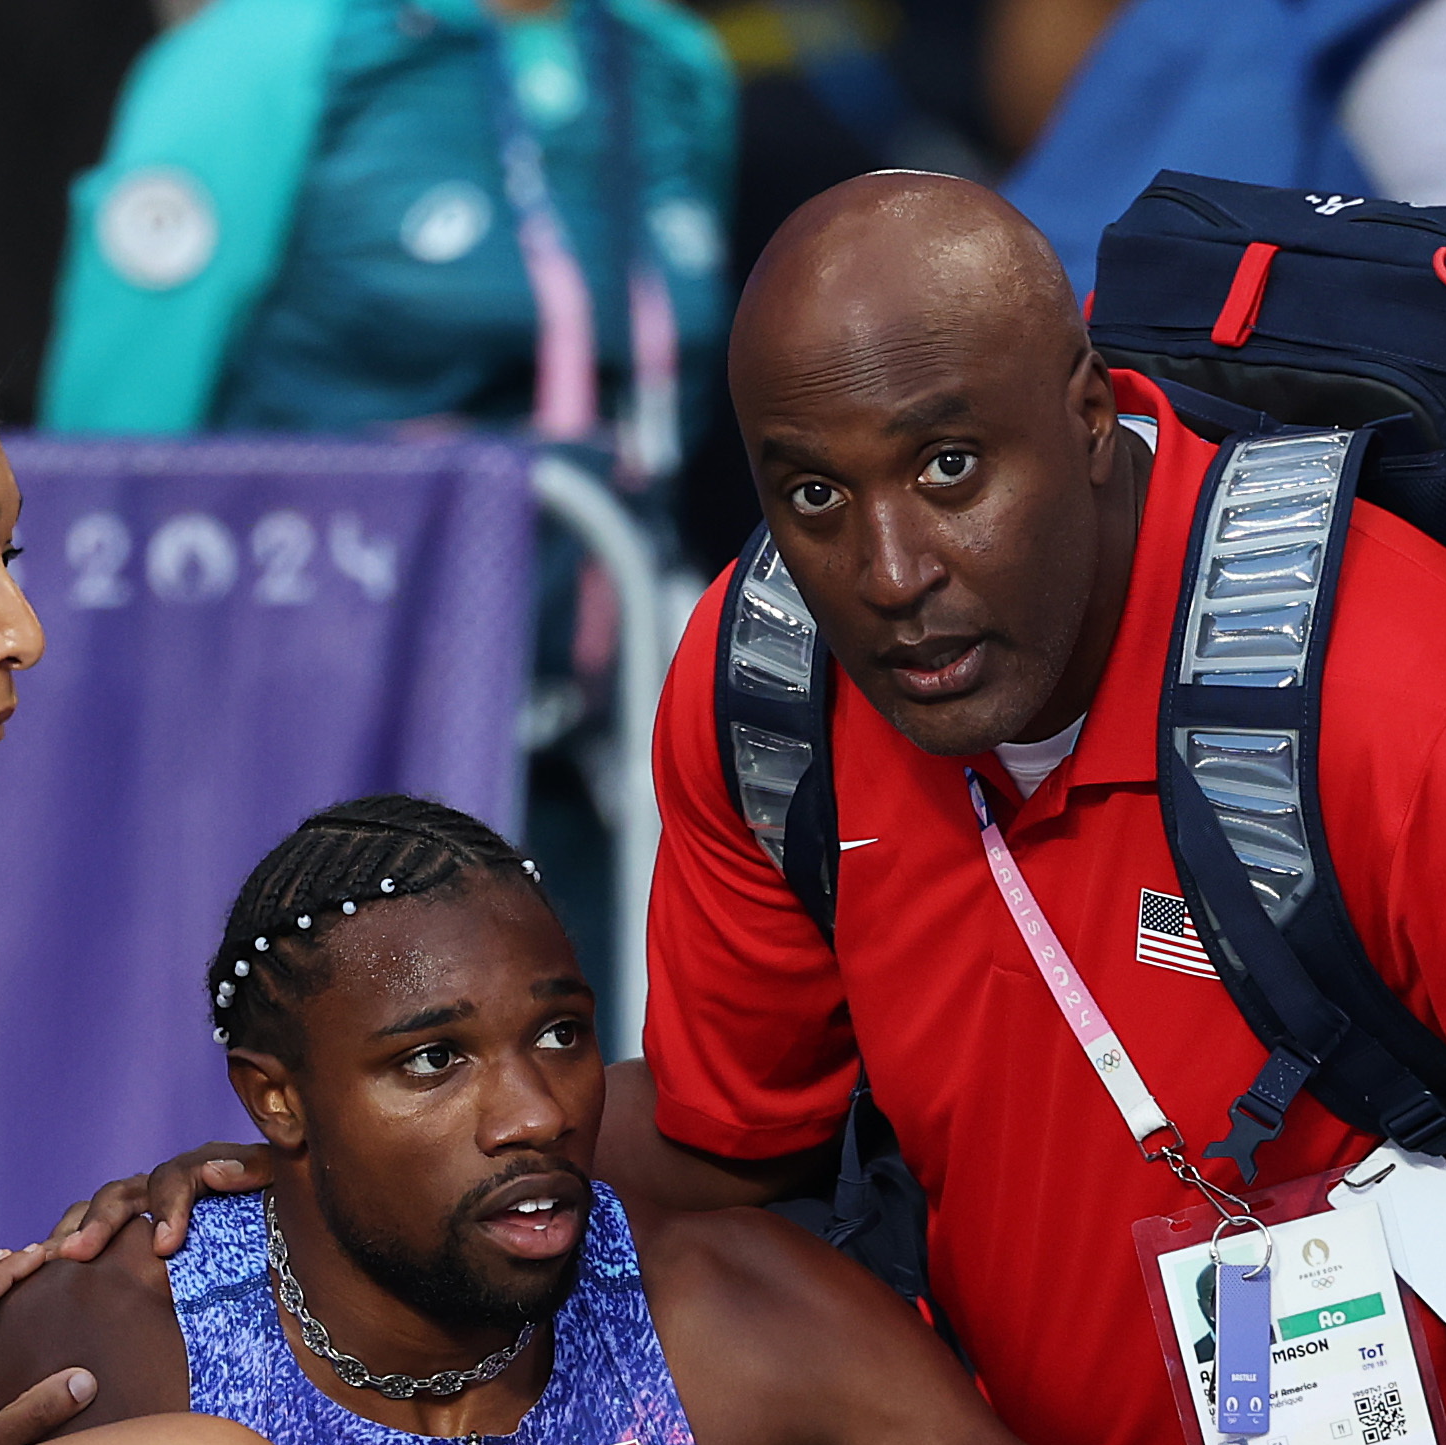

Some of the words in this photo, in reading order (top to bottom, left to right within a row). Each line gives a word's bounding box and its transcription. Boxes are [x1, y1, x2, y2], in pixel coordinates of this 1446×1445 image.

[65, 511, 400, 609] 2024
[989, 845, 1042, 937] PARIS
[1040, 944, 1092, 1030] 2024
[1317, 1310, 1347, 1329] Ao
[1272, 1338, 1329, 1364] MASON
[1358, 1343, 1385, 1361] ToT
[1230, 1373, 1259, 1382] BASTILLE
[1269, 1389, 1279, 1400] of
[1281, 1381, 1319, 1397] America
